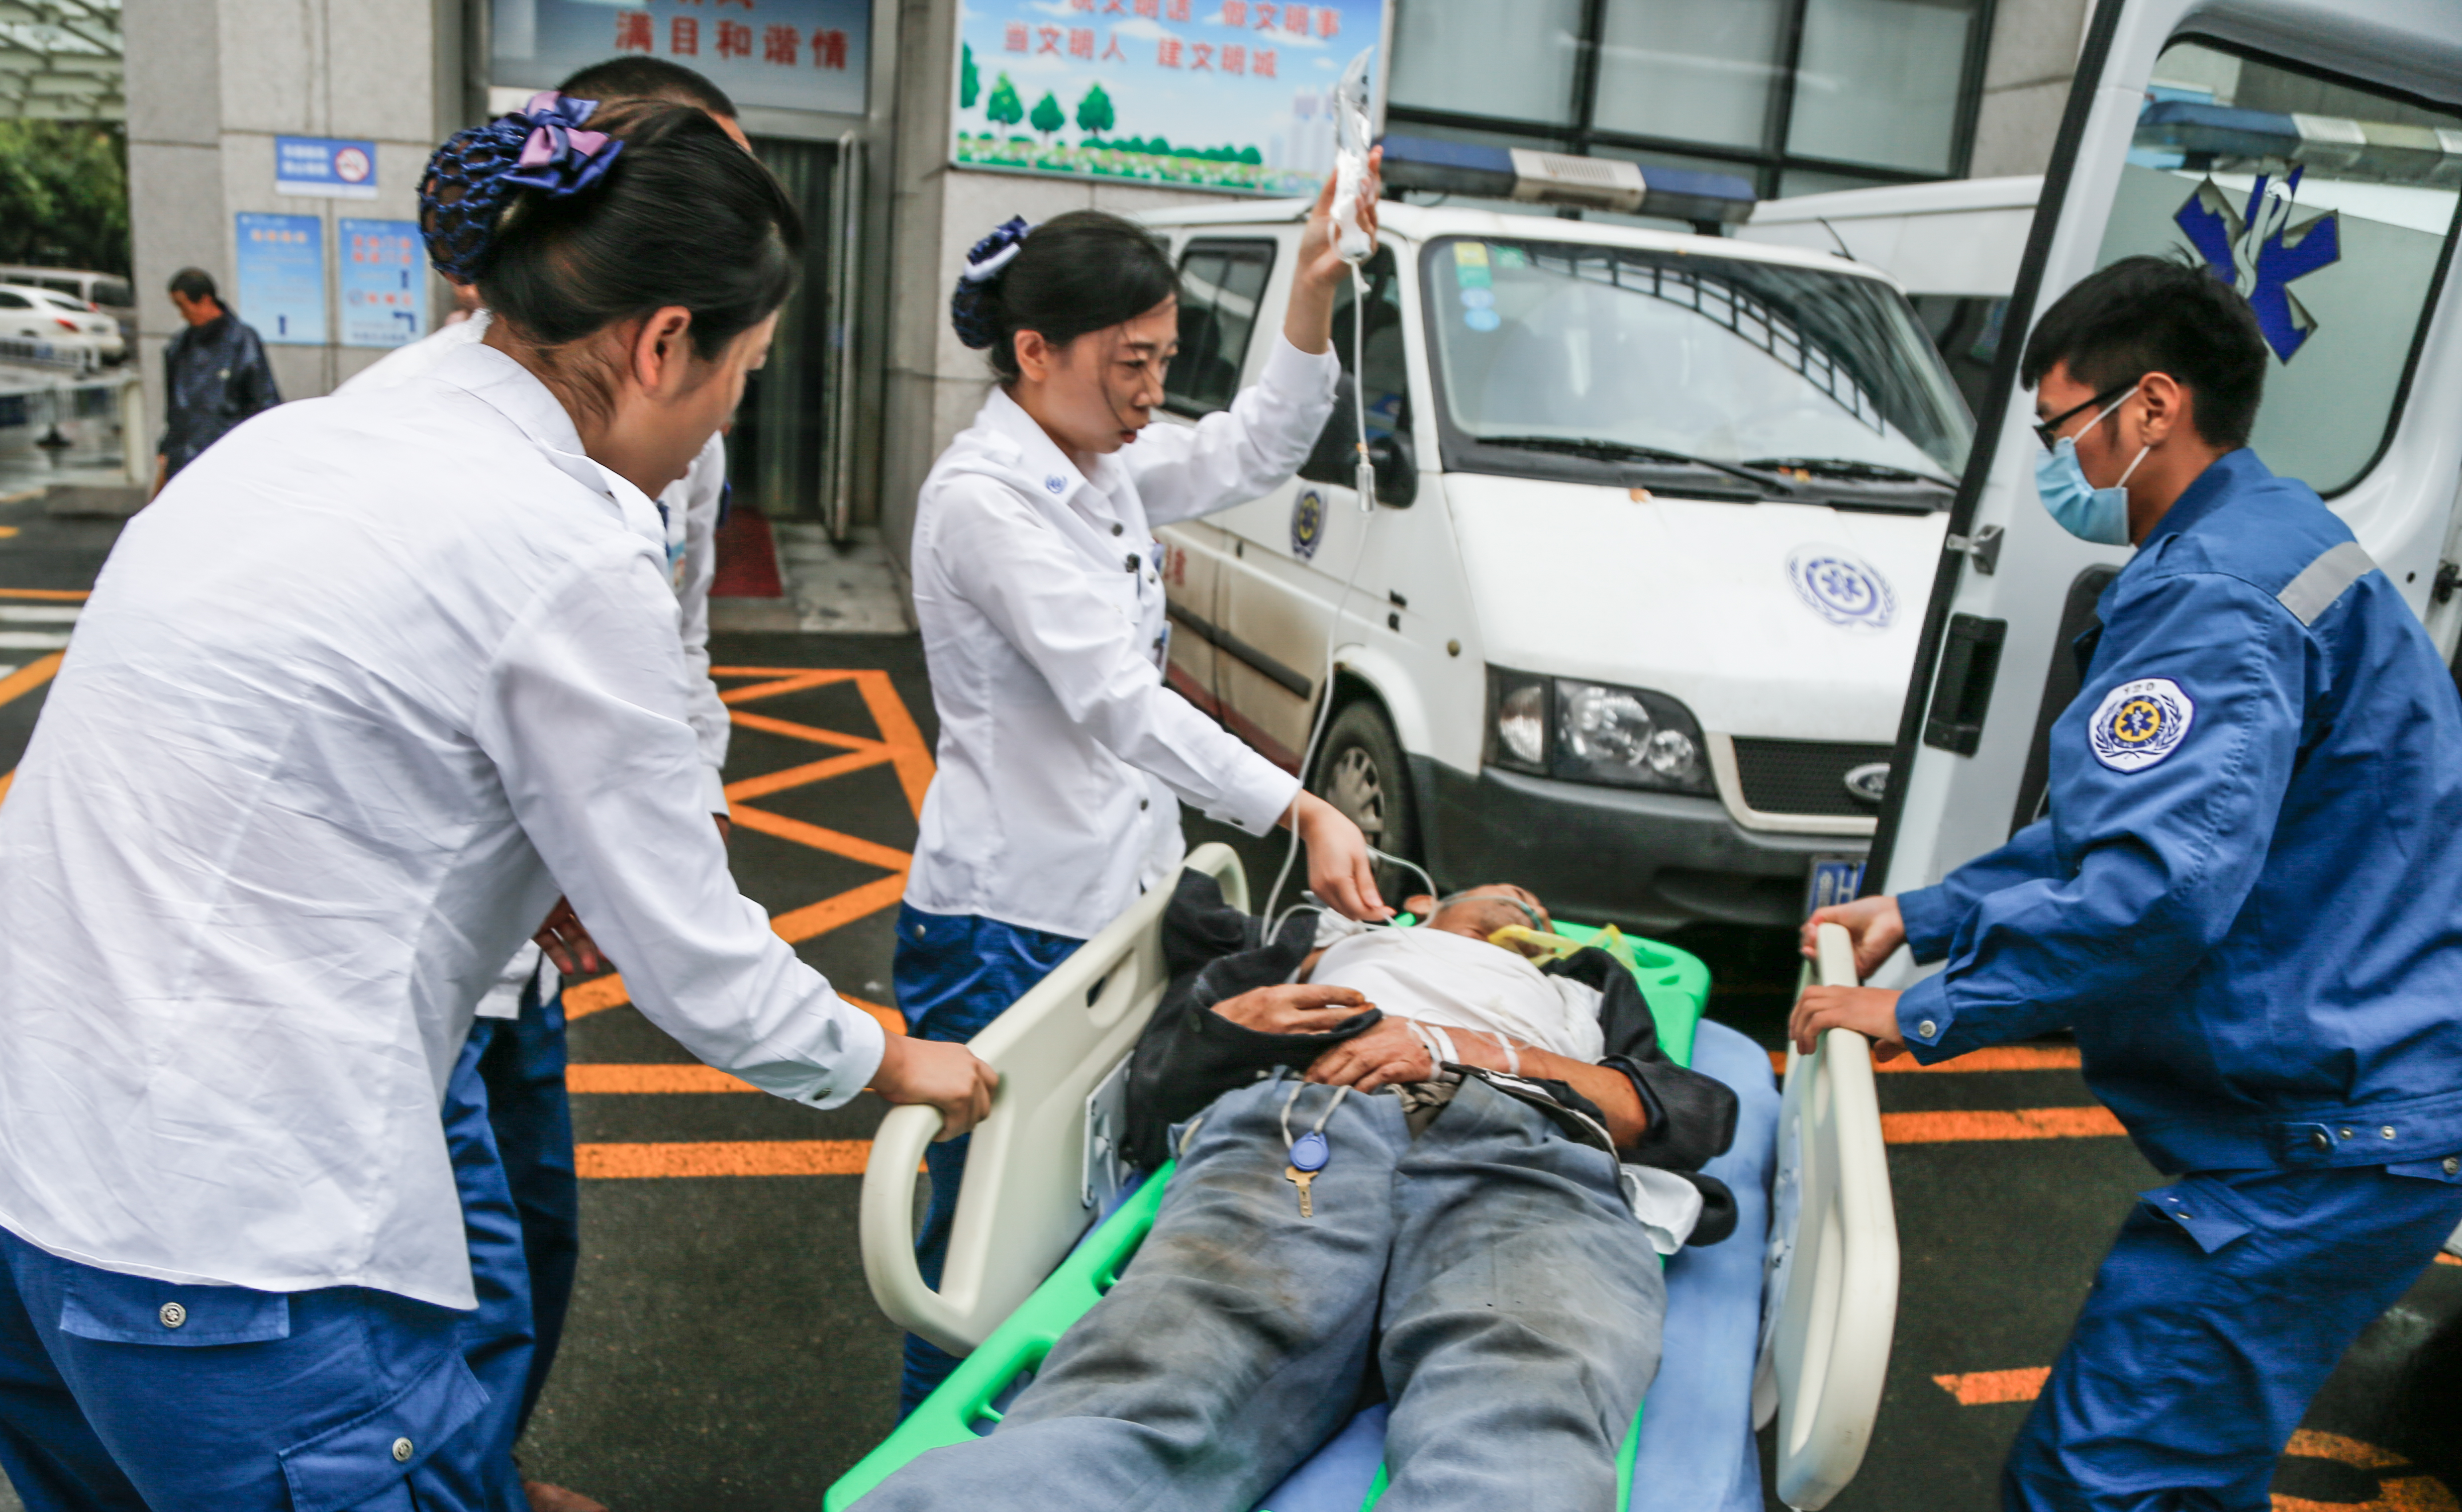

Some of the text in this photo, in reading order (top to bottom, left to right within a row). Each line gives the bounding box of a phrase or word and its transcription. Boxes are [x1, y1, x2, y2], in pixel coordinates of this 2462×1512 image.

[615, 11, 848, 69] 满目和谐情
[1005, 21, 1276, 77] 当文明人 建文明城
[2124, 682, 2154, 694] 120
